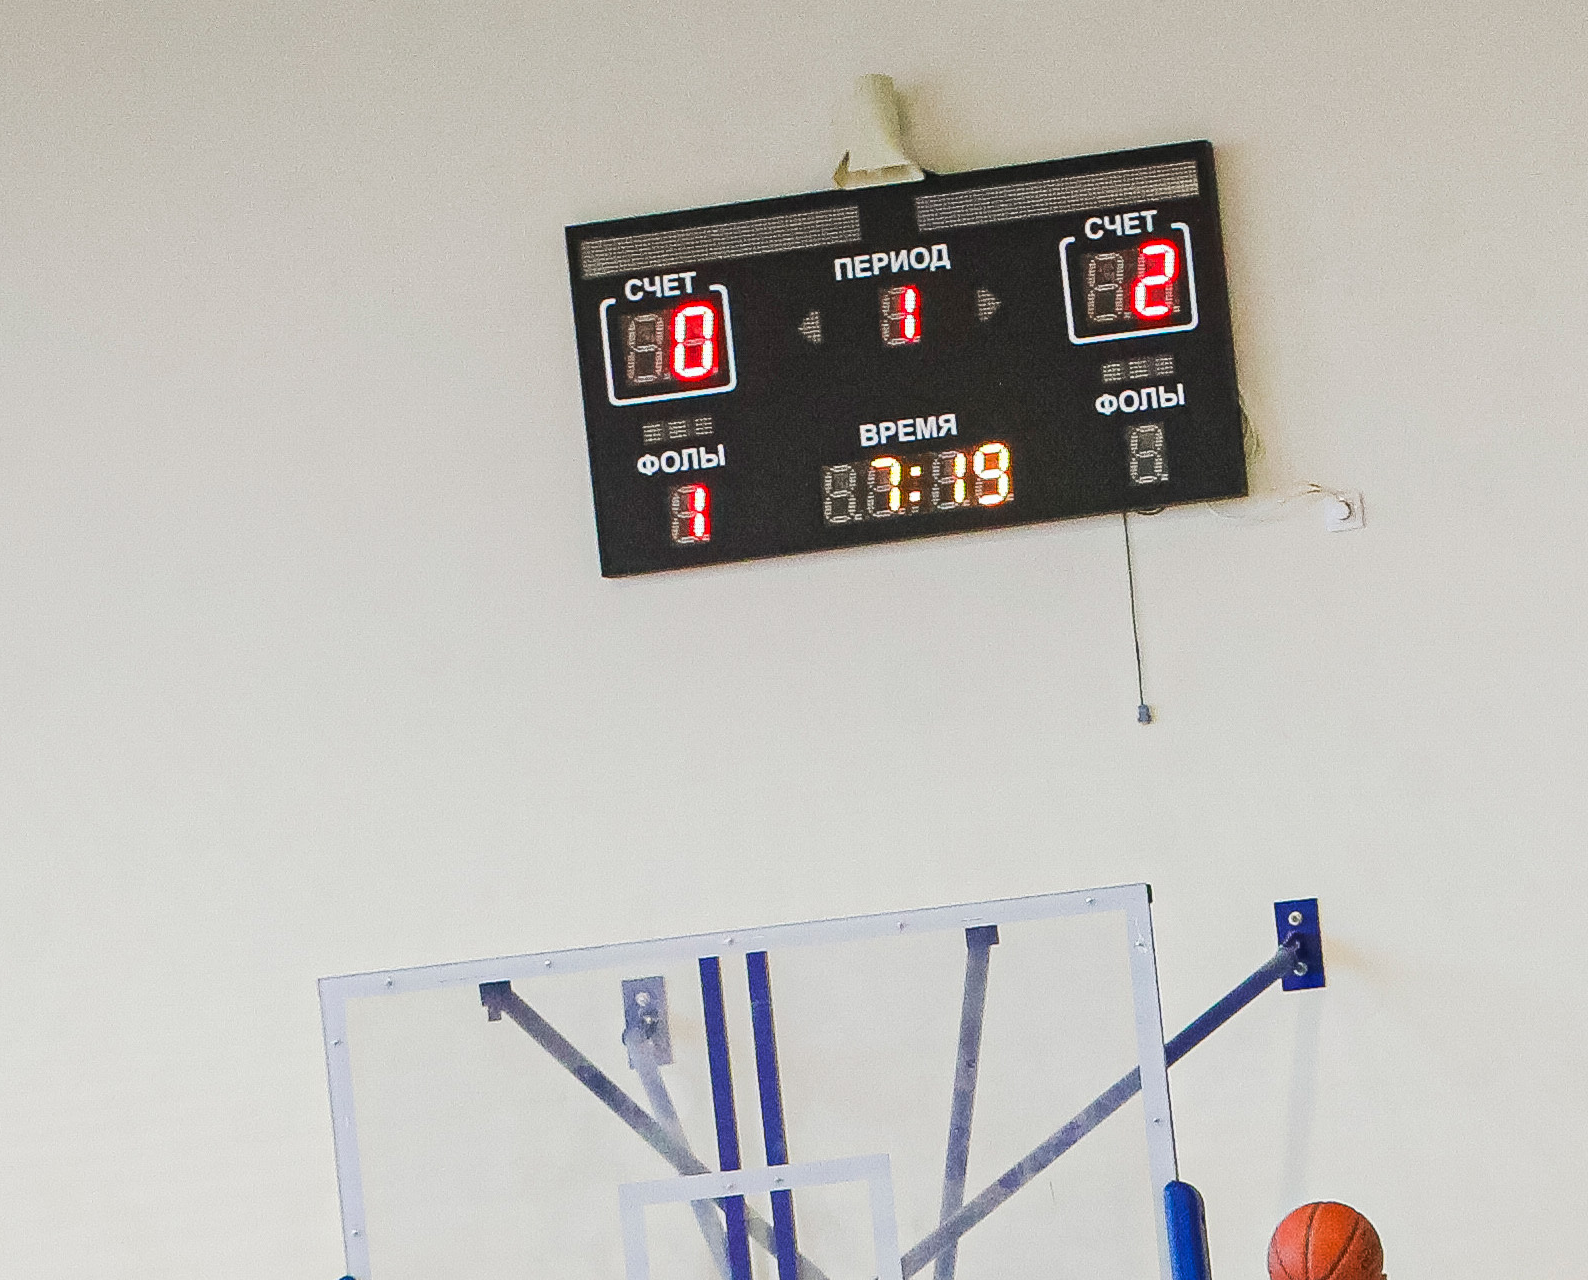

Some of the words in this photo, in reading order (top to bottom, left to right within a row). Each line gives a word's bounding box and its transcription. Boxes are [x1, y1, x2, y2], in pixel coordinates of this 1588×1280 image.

[1084, 209, 1158, 240] СЧЕТ
[833, 243, 951, 281] ПЕРИОД
[624, 271, 697, 301] СЧЕТ
[1132, 242, 1178, 320] 2
[673, 304, 715, 379] 0
[1094, 383, 1186, 416] ФОЛЫ
[859, 414, 958, 447] ВРЕМЯ
[636, 444, 726, 477] ФОЛЫ
